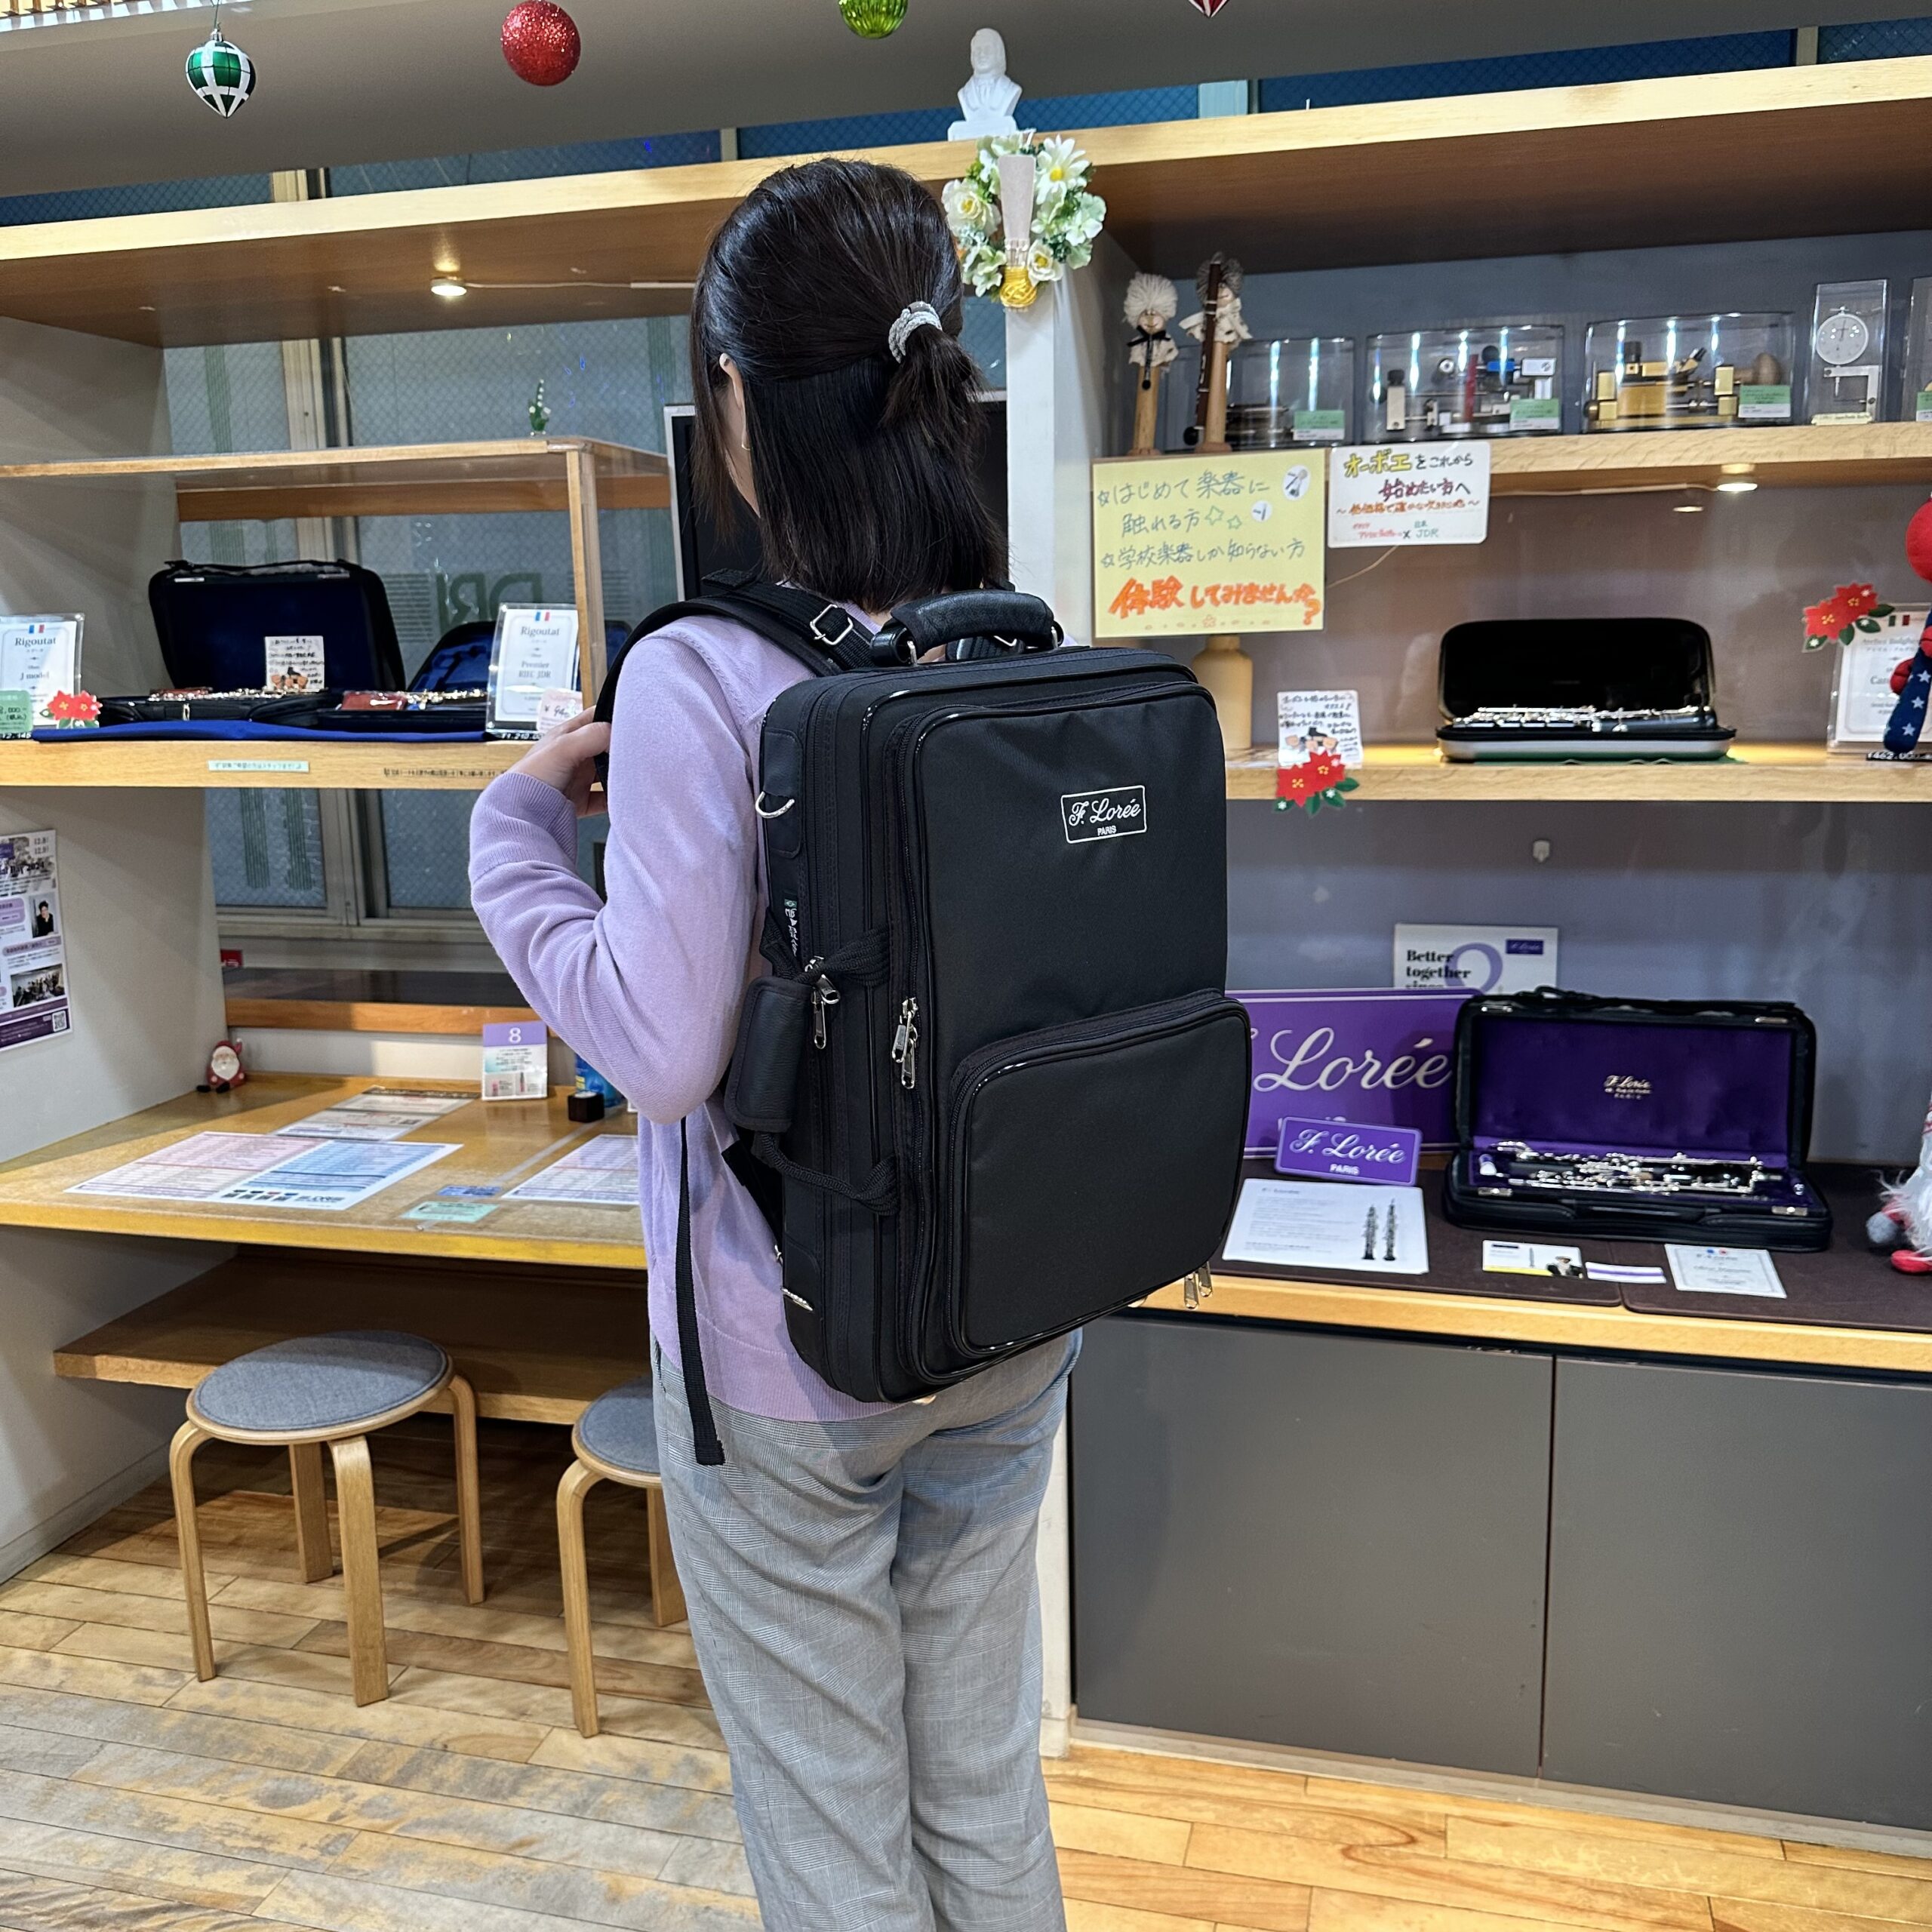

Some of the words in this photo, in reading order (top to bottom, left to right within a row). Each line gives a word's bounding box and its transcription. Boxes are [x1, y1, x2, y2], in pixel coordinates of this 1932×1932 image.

[1378, 478, 1471, 502] 始めたい方へ
[1121, 509, 1201, 537] 触れる方
[1118, 537, 1305, 570] 学校楽器しか知らない方
[521, 626, 561, 637] Rigoutat
[14, 637, 56, 648] Rigoutat
[1069, 801, 1089, 826] F.
[1089, 798, 1142, 823] Lorée
[1097, 825, 1117, 836] PARIS
[1406, 949, 1454, 963] Better
[1406, 965, 1472, 980] together
[509, 1027, 521, 1044] 8
[1253, 1026, 1453, 1092] Lorée
[1289, 1129, 1330, 1155] F.
[1321, 1134, 1406, 1164] Lorée
[1330, 1164, 1361, 1176] PARIS
